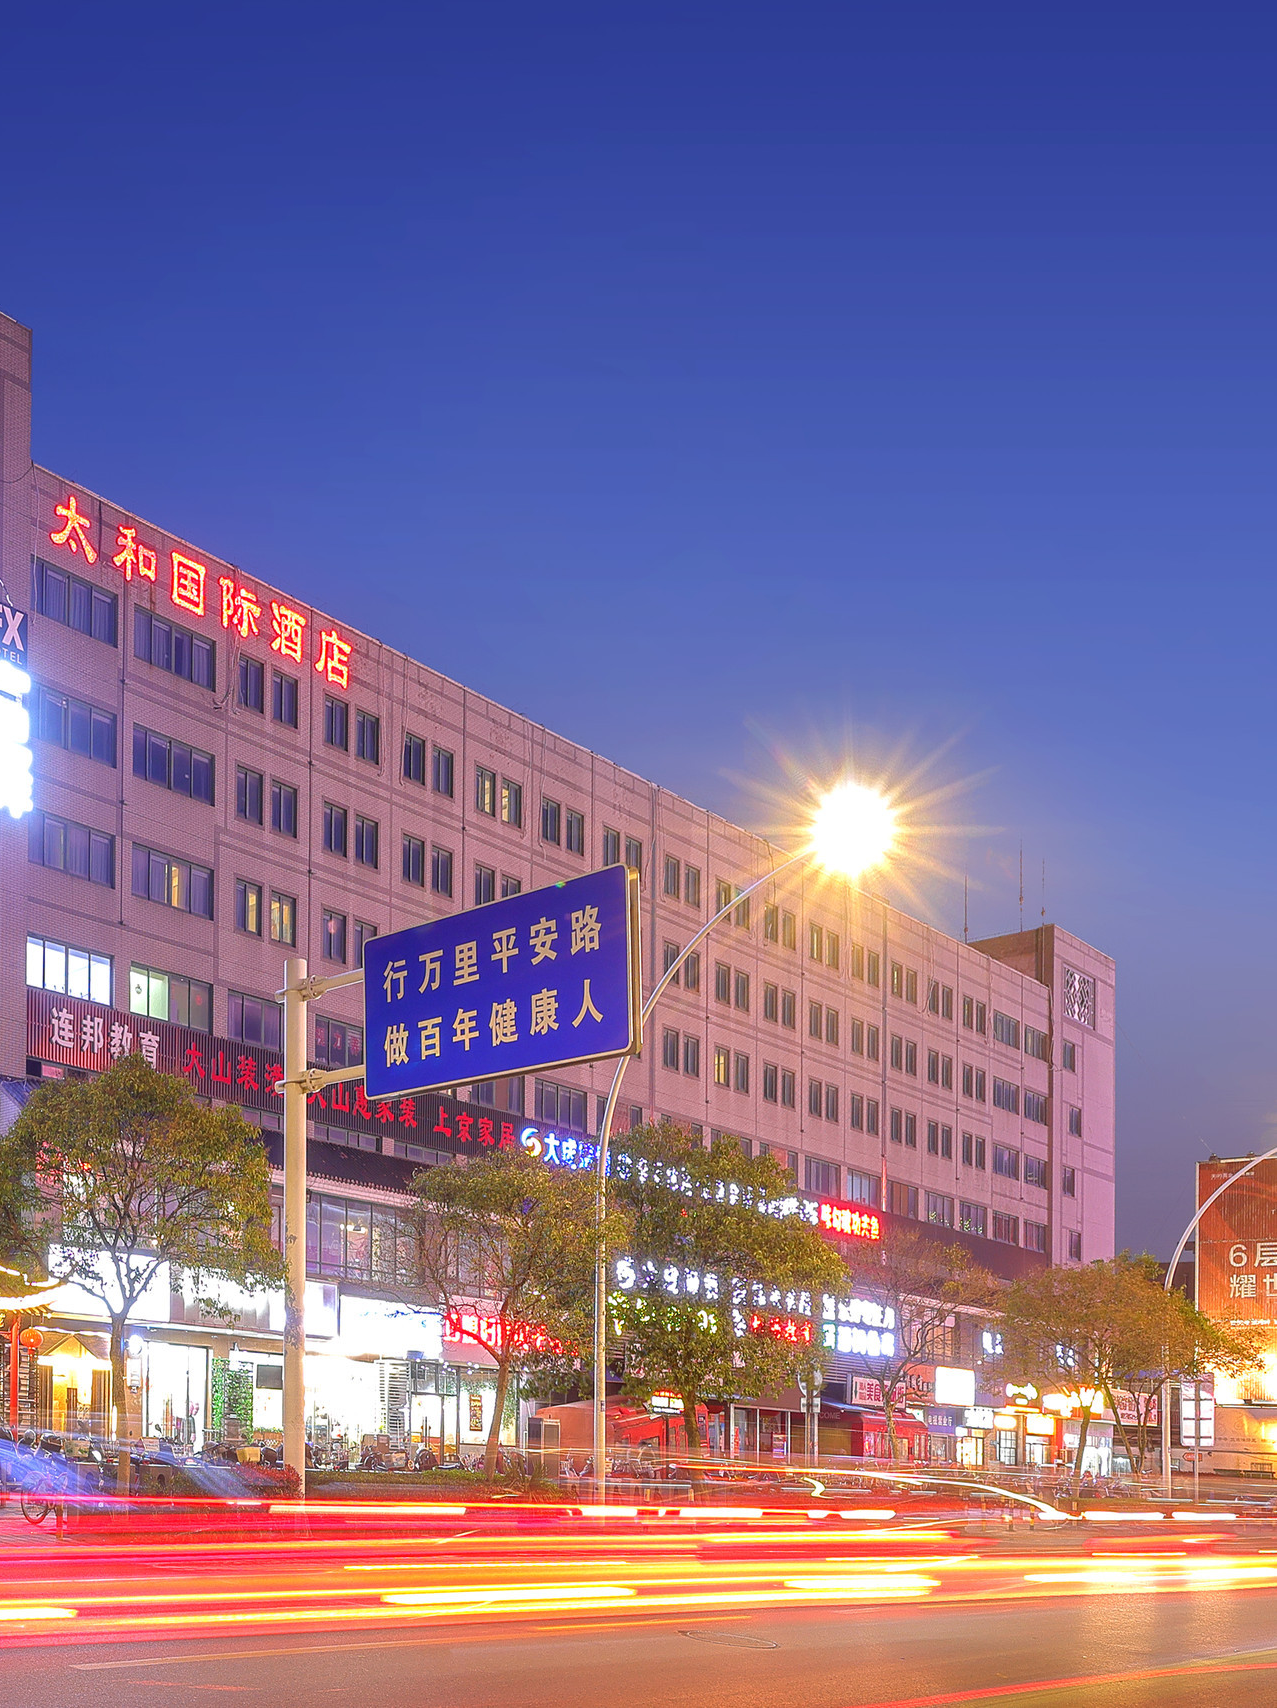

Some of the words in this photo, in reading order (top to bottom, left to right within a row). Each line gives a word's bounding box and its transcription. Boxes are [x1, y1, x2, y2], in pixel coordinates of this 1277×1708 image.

[50, 496, 352, 690] 太和国际酒店
[382, 904, 602, 1003] 行万里平安路
[50, 1007, 160, 1069] 连邦教育
[383, 979, 604, 1067] 做百年健康人
[433, 1105, 516, 1151] 上京家居
